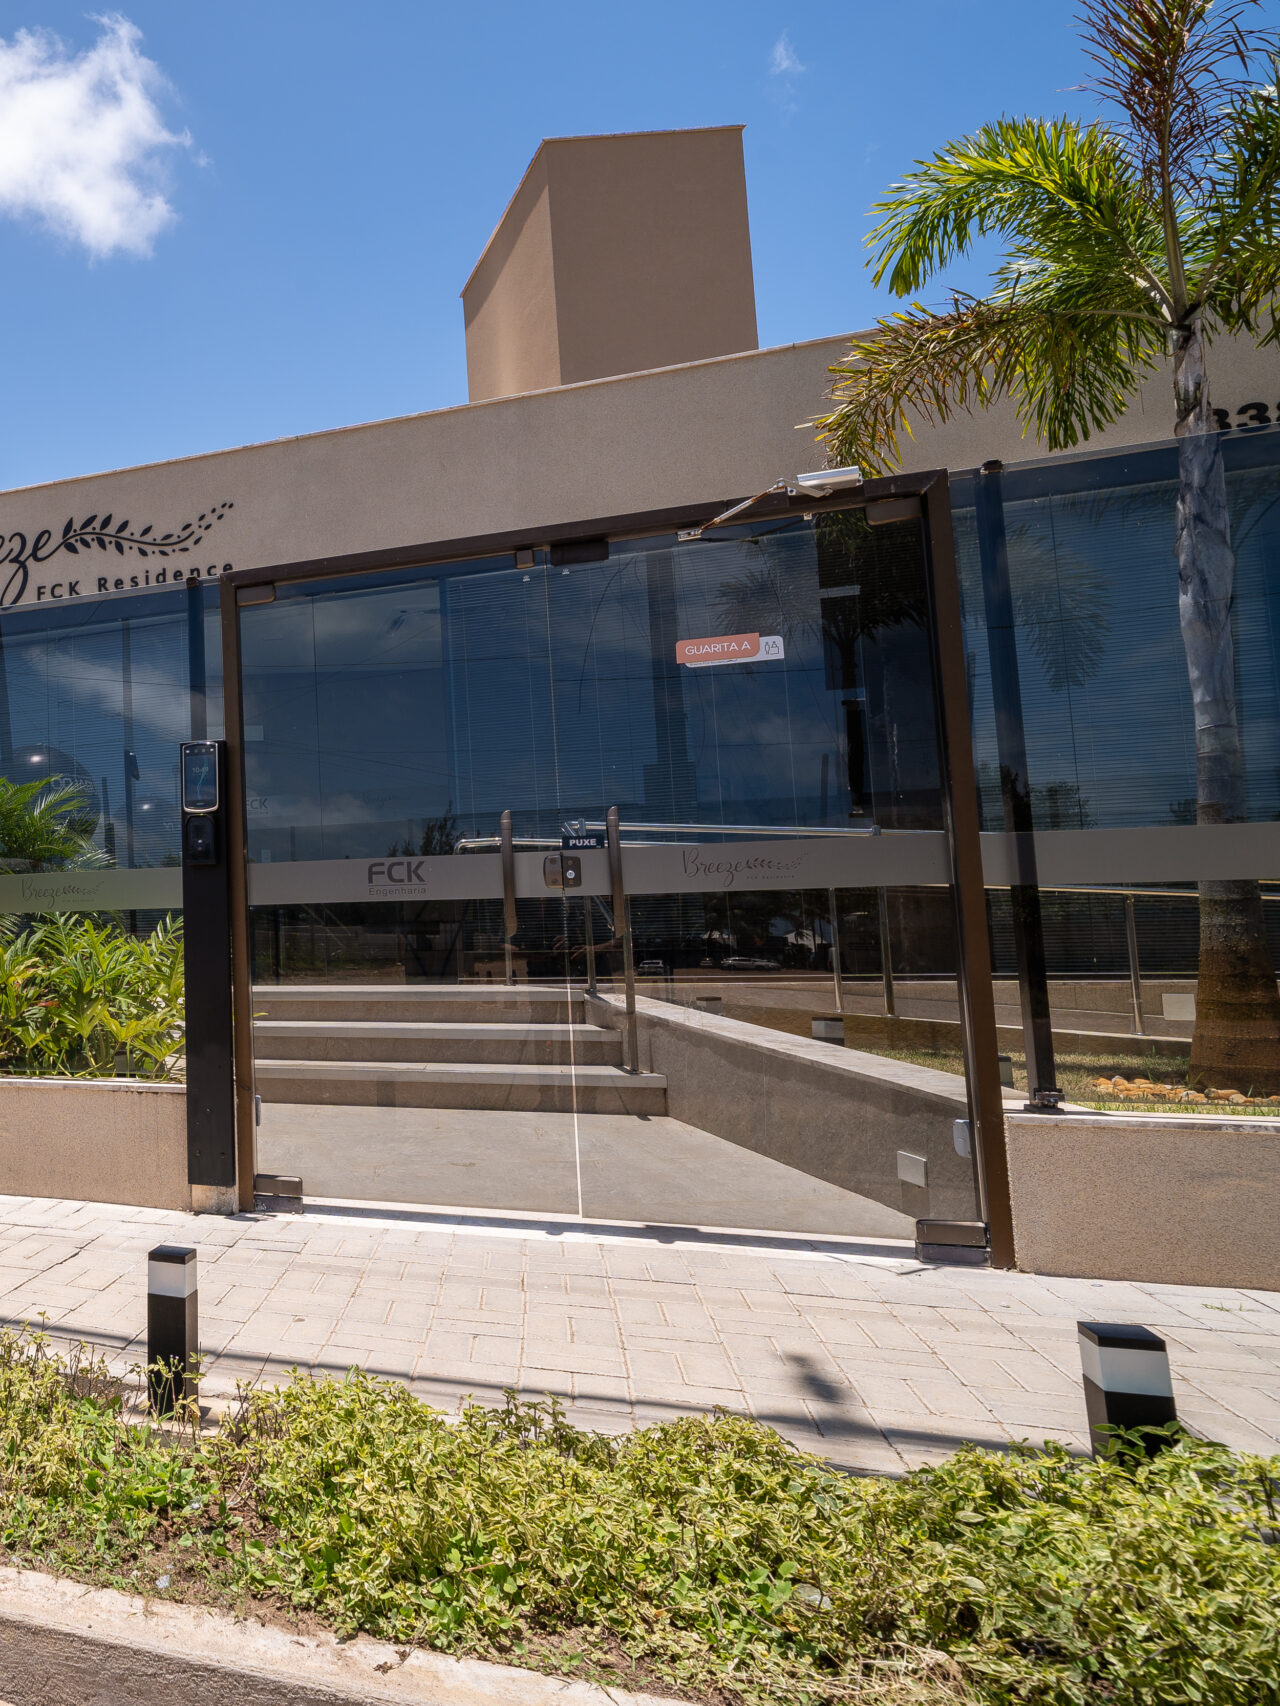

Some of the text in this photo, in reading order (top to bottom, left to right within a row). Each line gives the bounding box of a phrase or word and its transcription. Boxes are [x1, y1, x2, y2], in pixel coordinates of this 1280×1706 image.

[37, 562, 233, 601] FCK Residence
[685, 641, 751, 655] GUARITA A
[569, 838, 597, 847] PUXE
[368, 860, 426, 884] FCK
[682, 847, 744, 888] Breeze
[21, 877, 61, 909] Breeze
[368, 887, 427, 897] Engenharia
